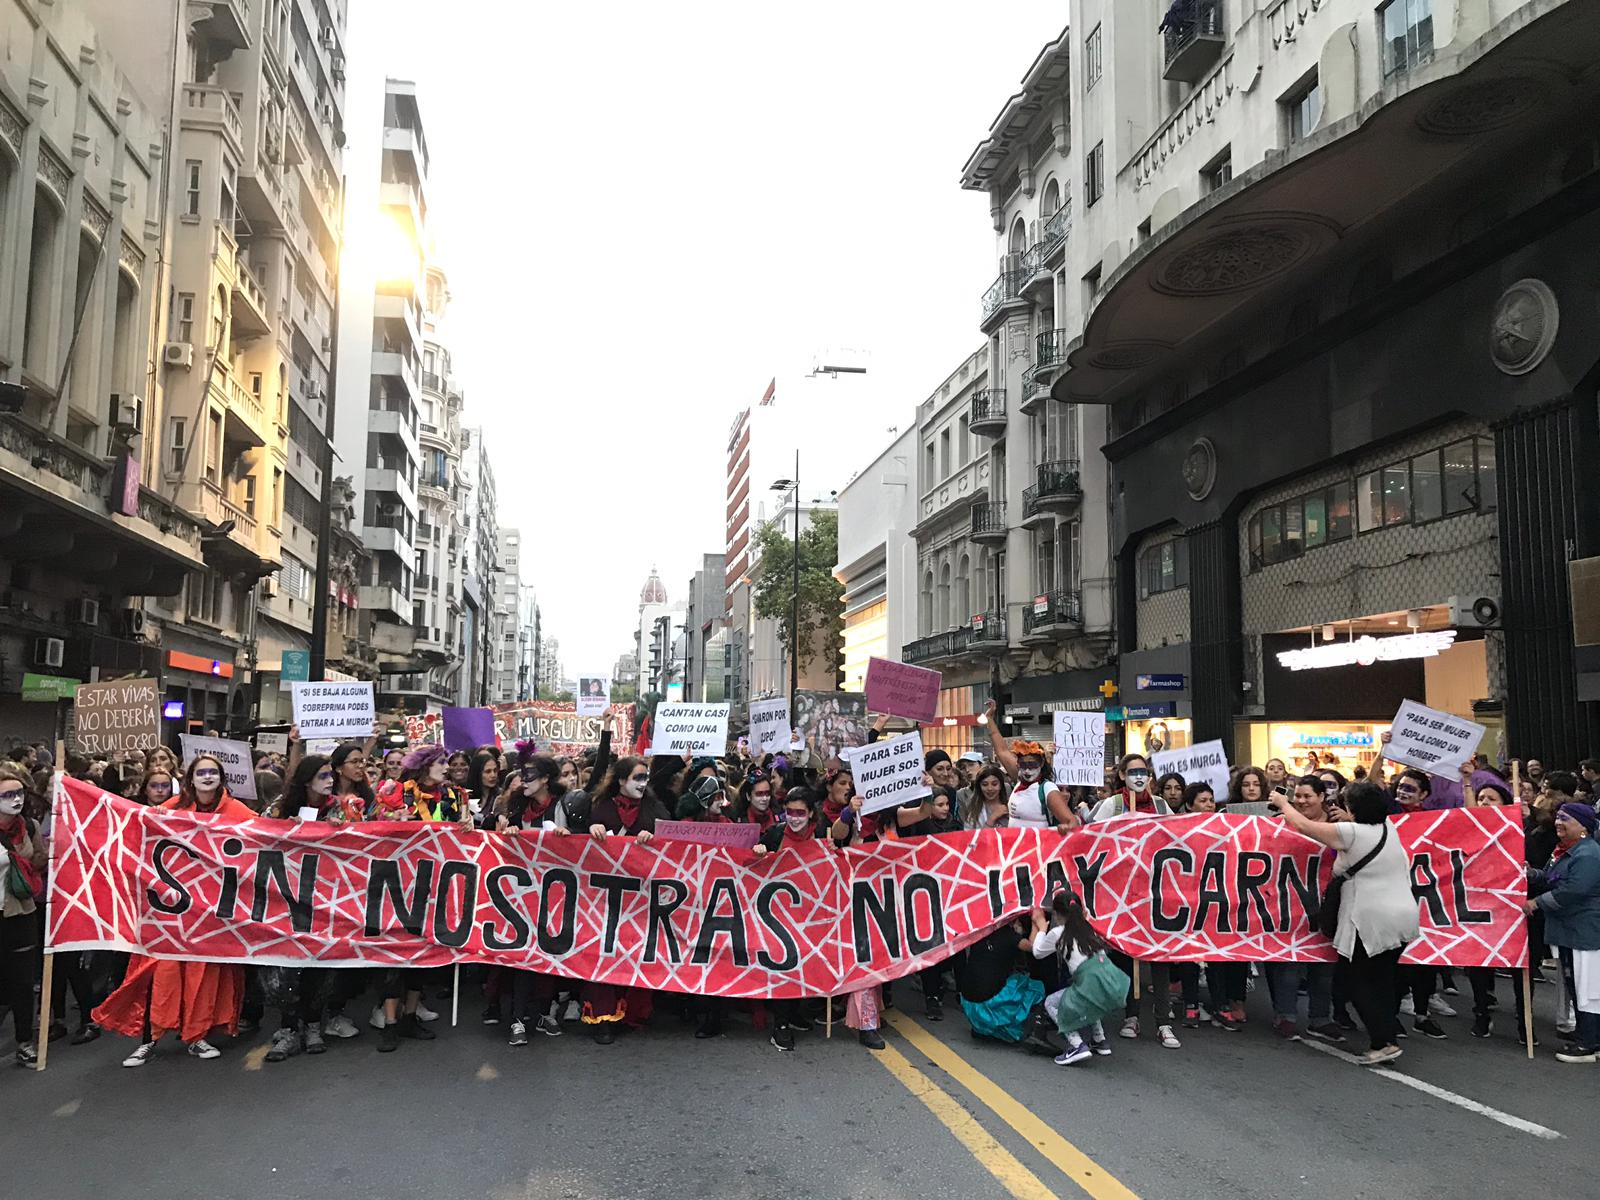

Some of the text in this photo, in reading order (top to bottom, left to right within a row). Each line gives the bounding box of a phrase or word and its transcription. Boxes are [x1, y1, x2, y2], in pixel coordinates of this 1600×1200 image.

[312, 688, 321, 696] SE
[323, 688, 340, 696] BAJA
[341, 688, 368, 696] ALGUNA
[302, 703, 346, 712] SOBREPRIMA
[660, 708, 729, 718] "CANTAN CASI
[774, 709, 787, 720] POR
[78, 712, 100, 731] NO
[300, 719, 329, 728] ENTRAR
[336, 718, 345, 726] LA
[665, 724, 717, 734] COMO UNA
[1406, 712, 1471, 740] "PARA SER MUJER
[78, 732, 158, 755] SER UN LOGRO
[1401, 728, 1461, 754] SOPLA COMO UN
[861, 742, 913, 764] "PARA SER
[861, 758, 919, 783] MUJER SOS
[1159, 753, 1221, 774] "NO ES MURGA
[225, 772, 248, 785] BAJOS"
[865, 776, 921, 800] GRACIOSA"
[363, 859, 800, 971] NOSOTRAS
[851, 872, 945, 964] NO
[1150, 848, 1492, 934] CARNAL
